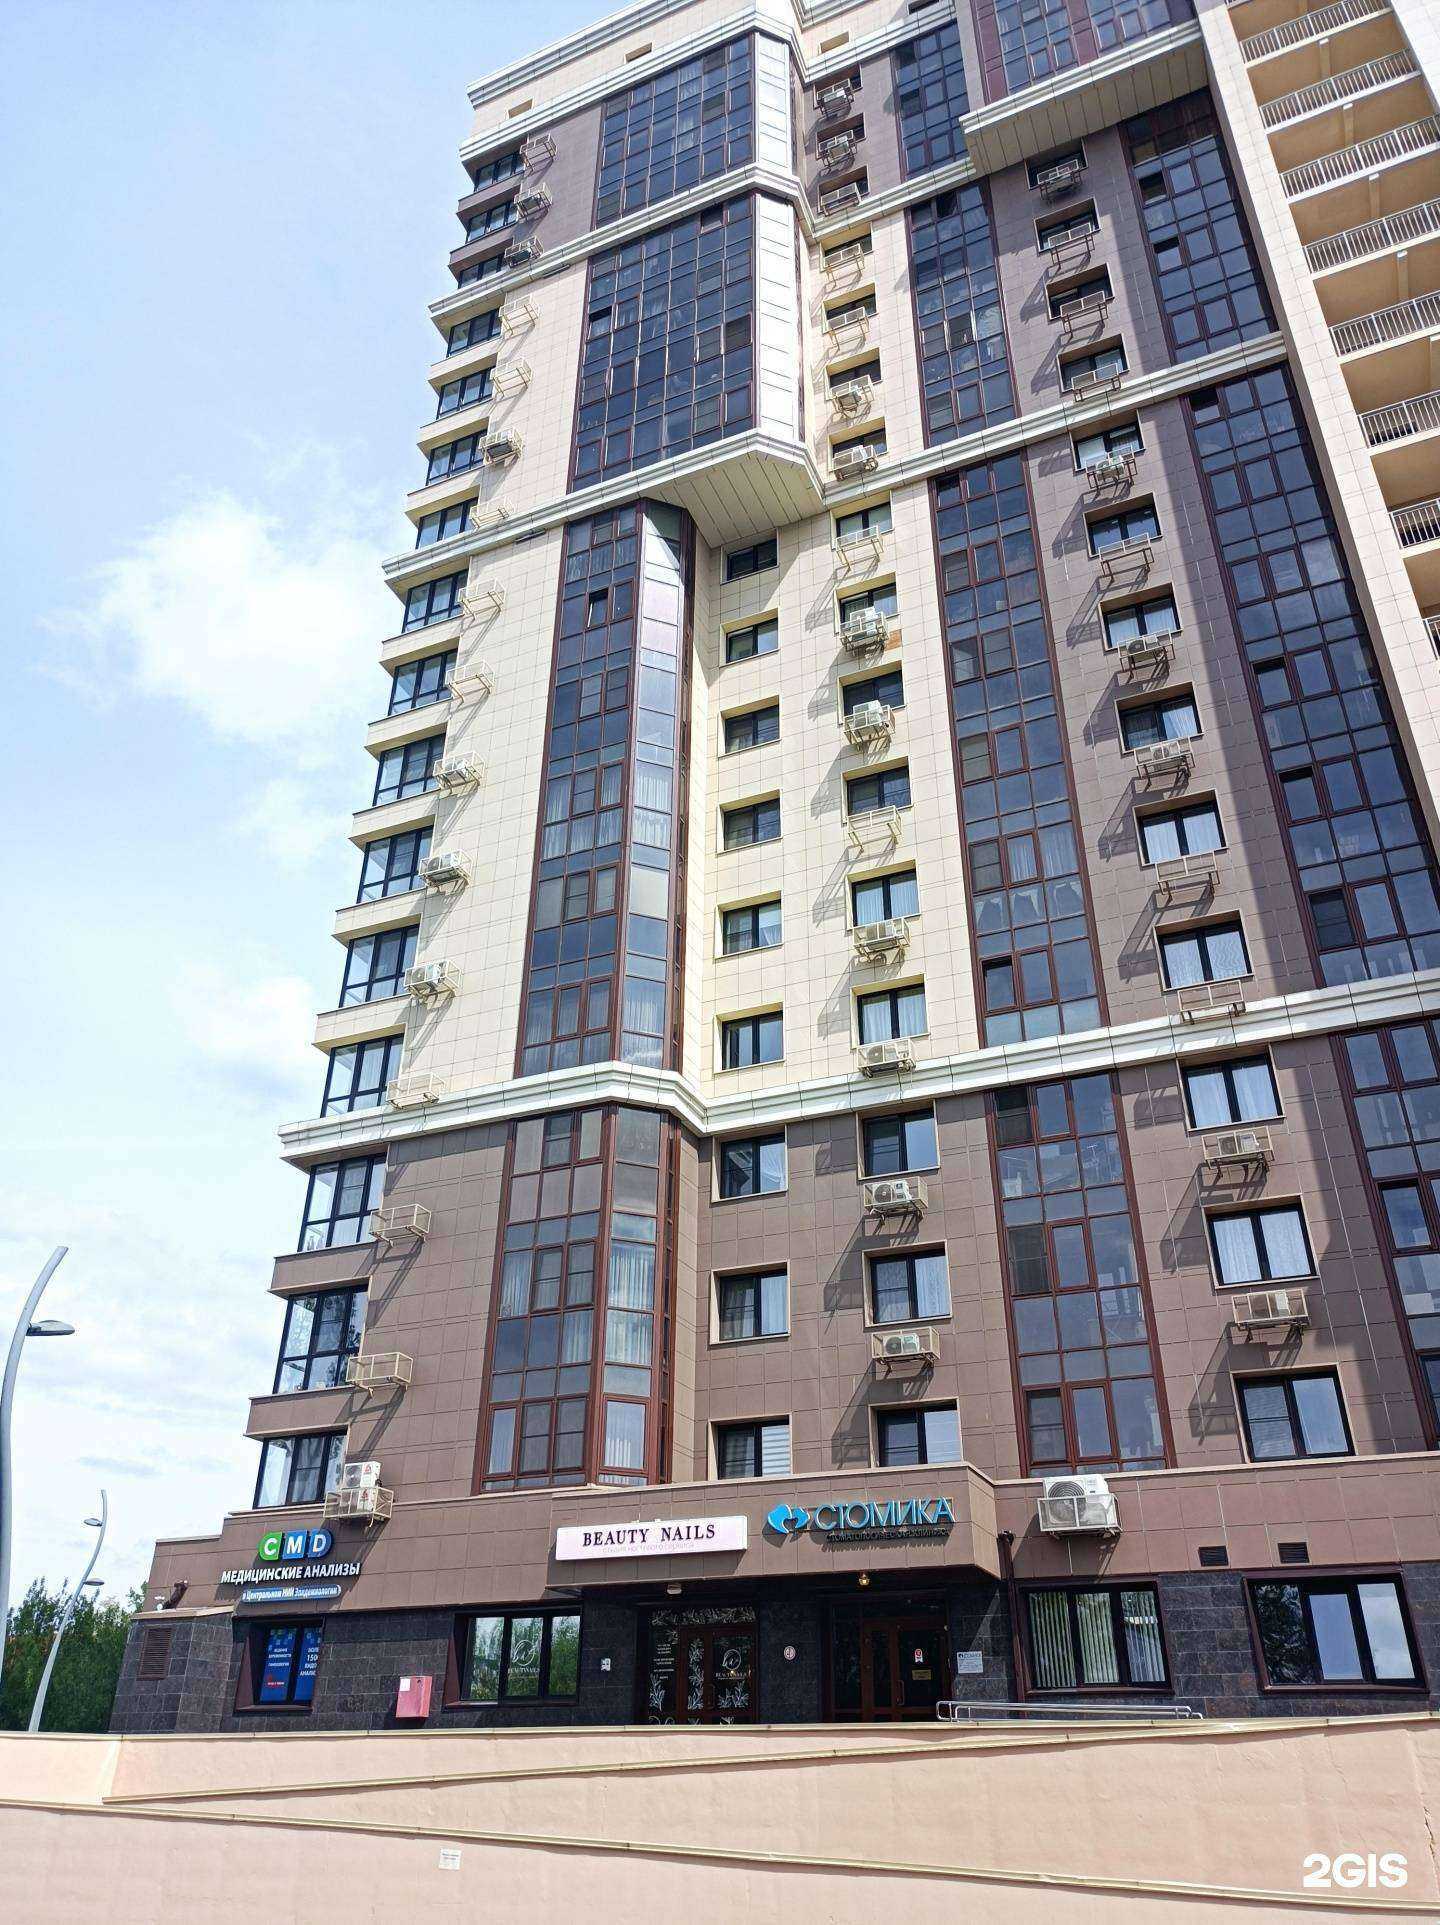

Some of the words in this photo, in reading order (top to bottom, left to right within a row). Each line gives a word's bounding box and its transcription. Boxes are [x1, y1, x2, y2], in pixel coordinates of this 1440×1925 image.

[814, 1496, 957, 1530] СТОМИКА
[264, 1534, 327, 1556] CMD
[583, 1529, 650, 1546] BEAUTY
[661, 1524, 716, 1542] NAILS
[221, 1566, 302, 1585] МЕДИЦИНСКИЕ
[304, 1563, 360, 1579] АНАЛИЗЫ
